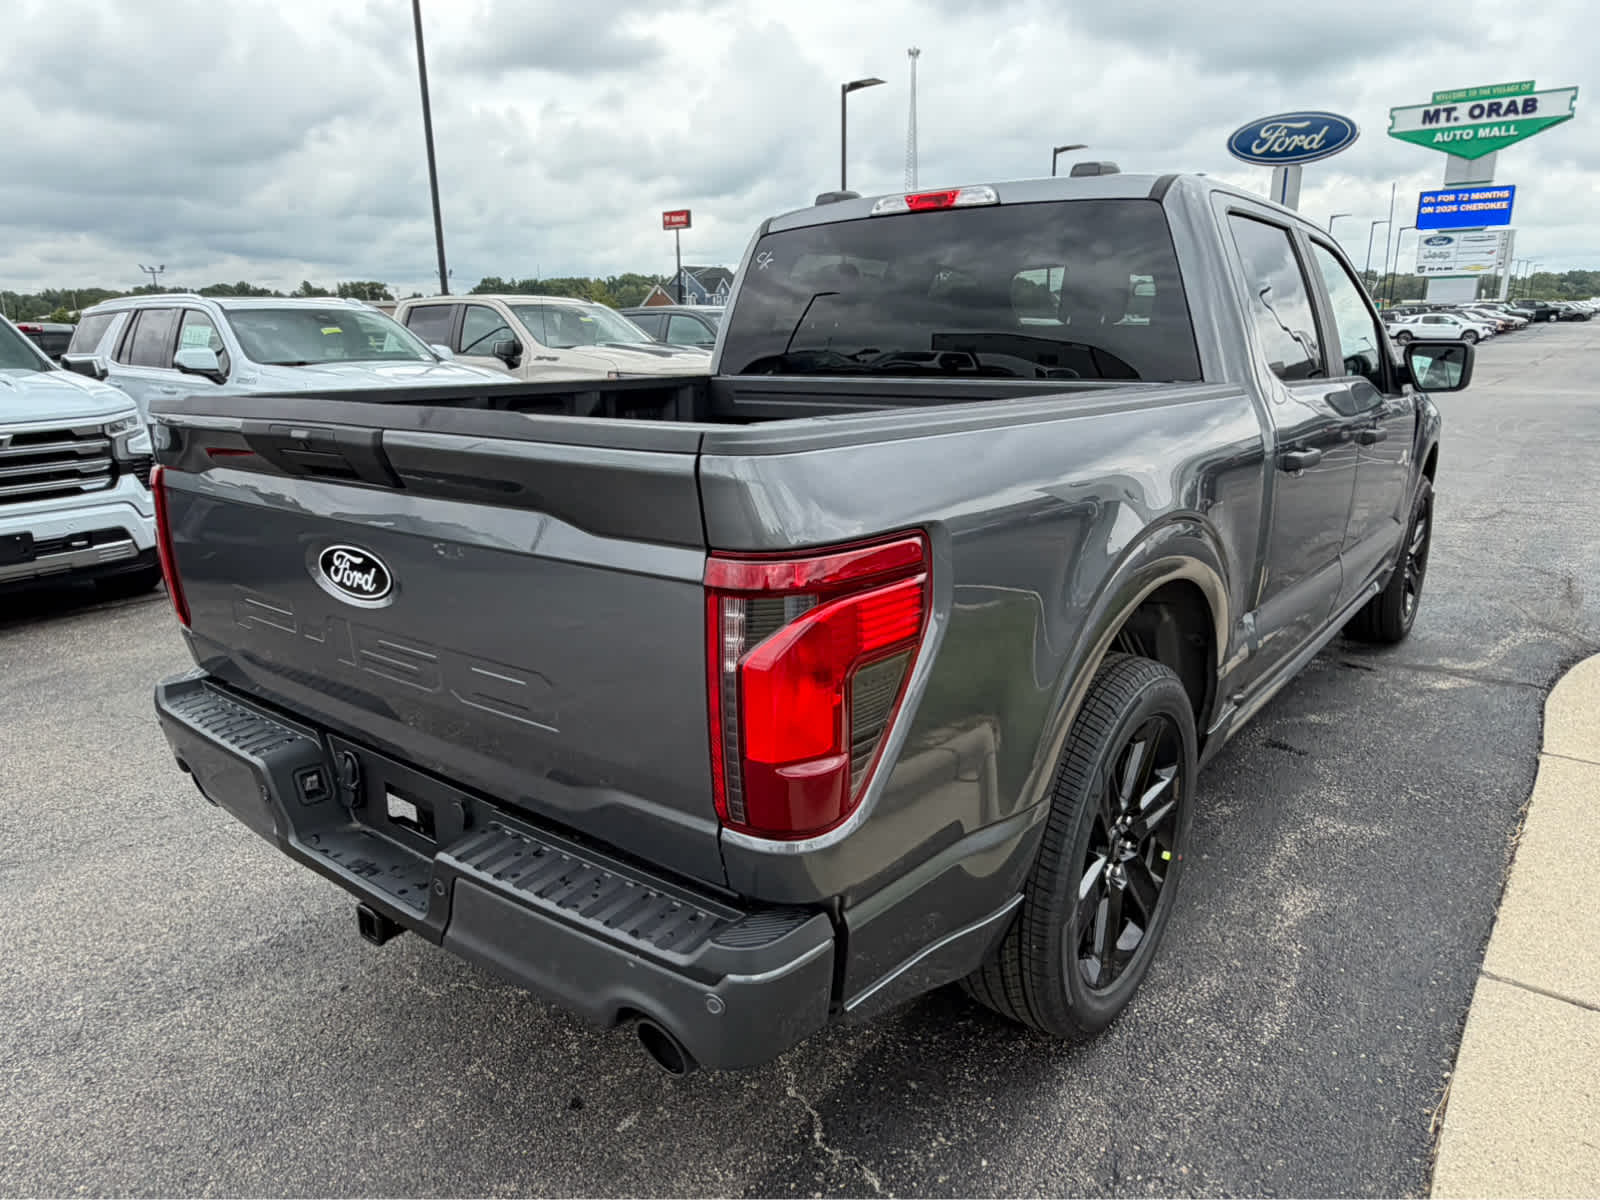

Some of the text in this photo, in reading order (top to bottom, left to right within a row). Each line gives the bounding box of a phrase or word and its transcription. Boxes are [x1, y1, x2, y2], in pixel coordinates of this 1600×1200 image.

[1421, 98, 1538, 125] MT. ORAB
[1251, 121, 1329, 154] Ford
[1433, 125, 1519, 143] AUTO MALL
[1437, 194, 1456, 202] FOR
[1458, 193, 1469, 201] 72
[1471, 190, 1510, 200] MONTHS
[1421, 206, 1434, 214] ON
[1460, 202, 1509, 211] CHEROKEE
[330, 550, 376, 592] Ford
